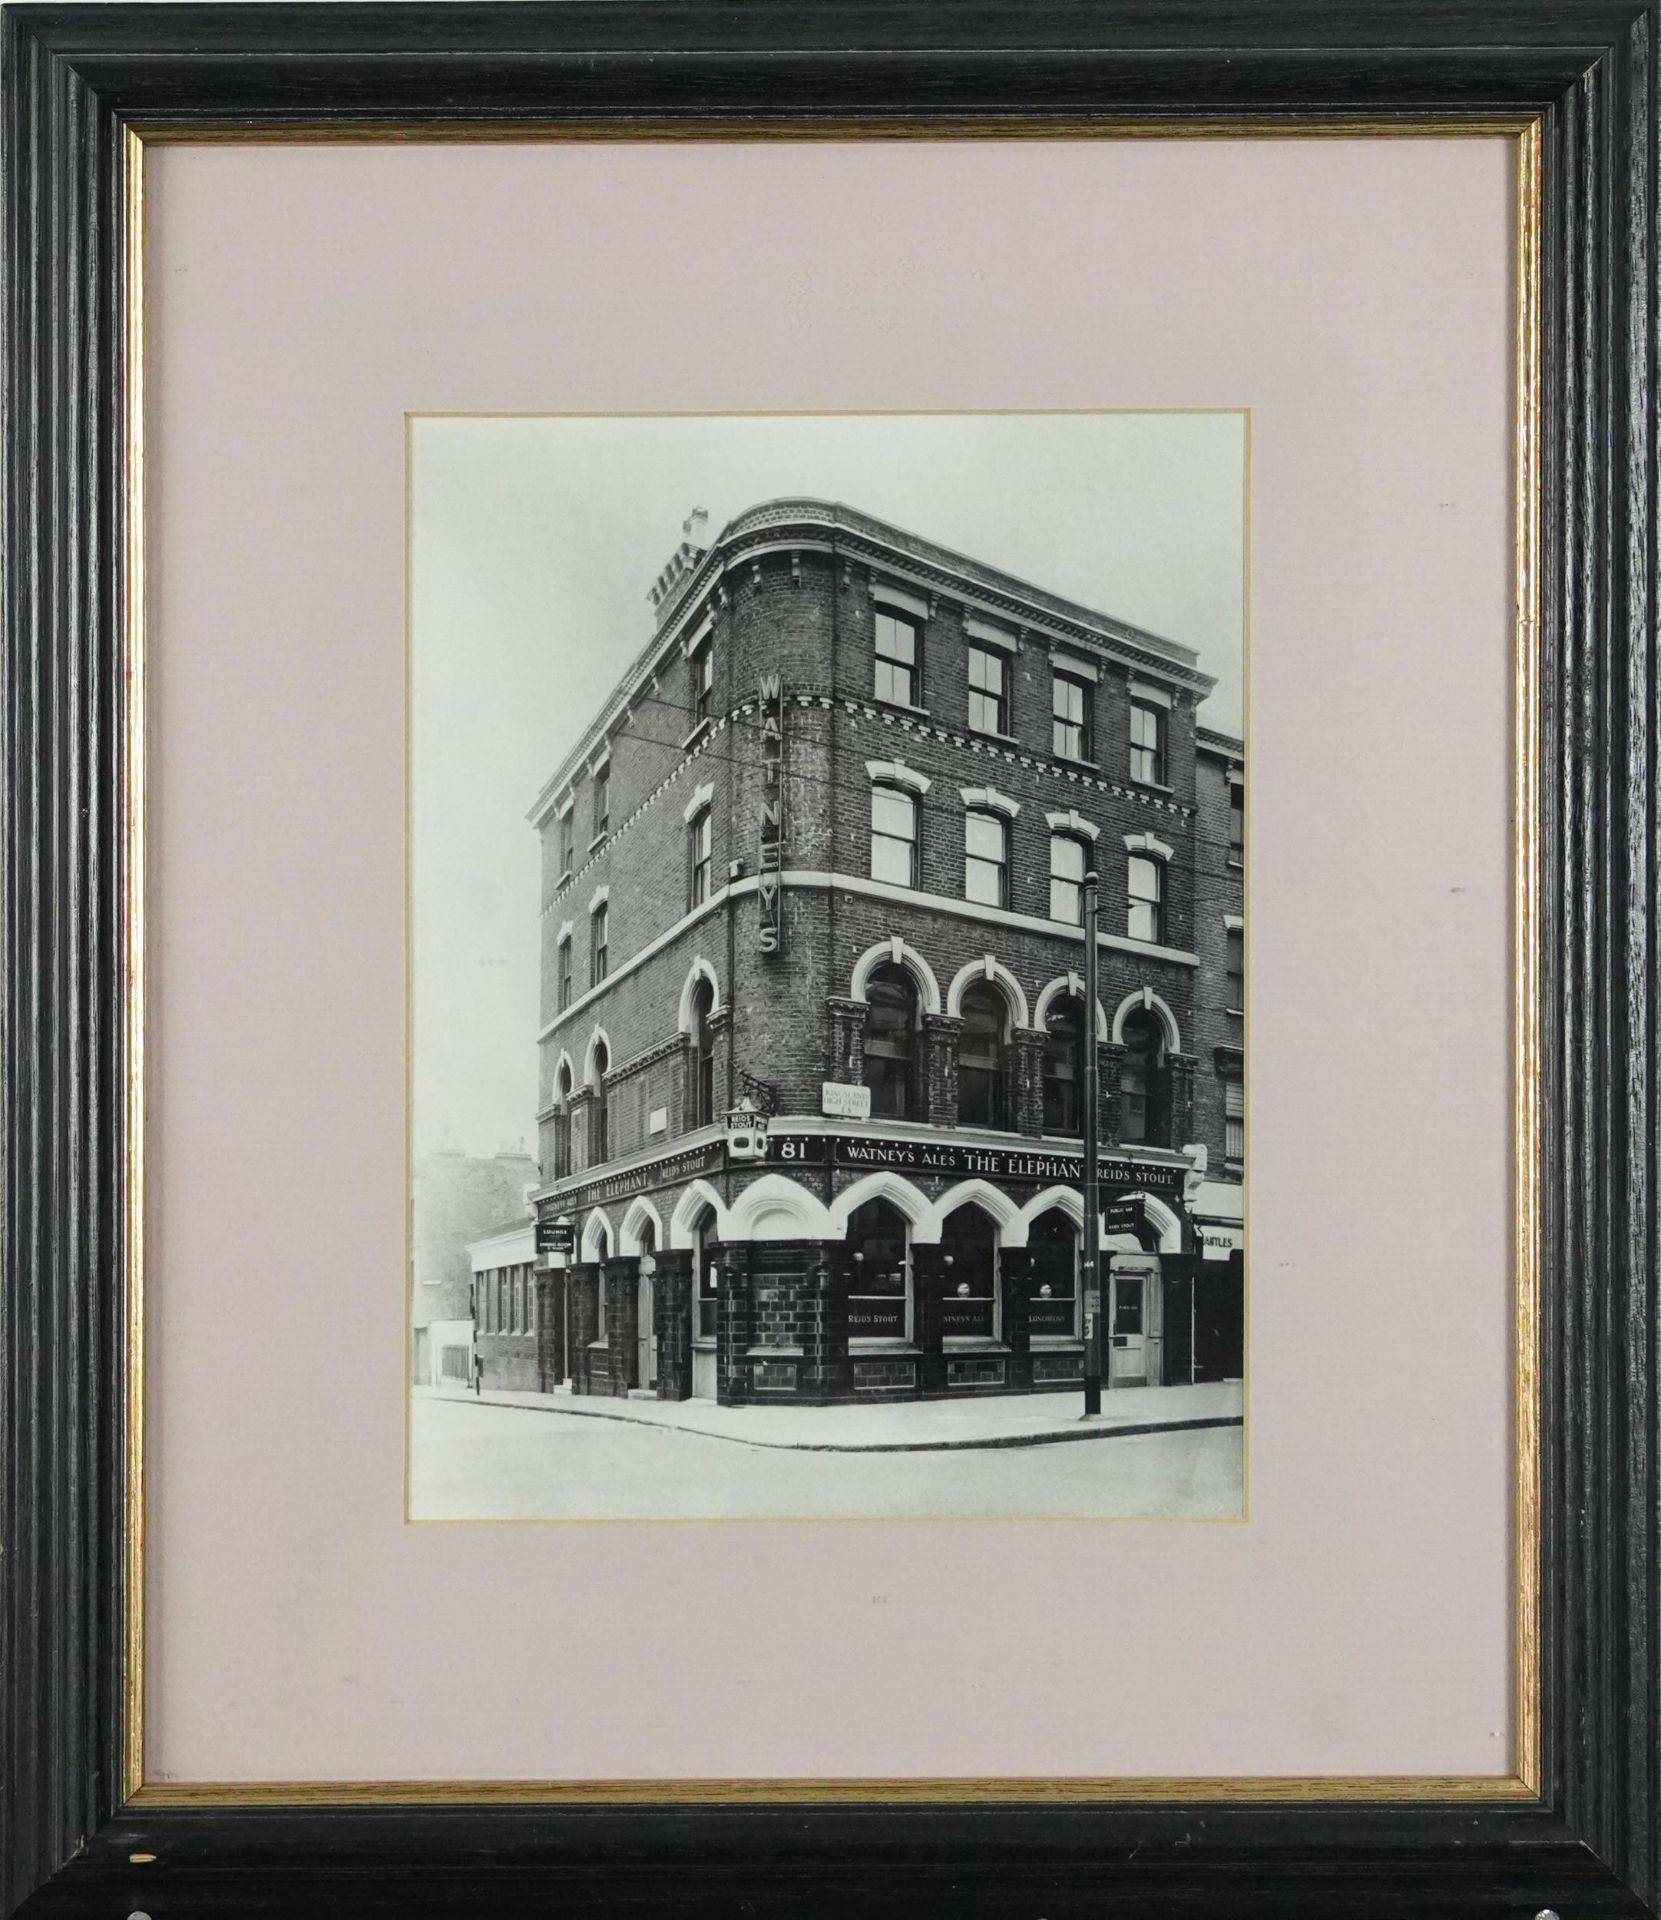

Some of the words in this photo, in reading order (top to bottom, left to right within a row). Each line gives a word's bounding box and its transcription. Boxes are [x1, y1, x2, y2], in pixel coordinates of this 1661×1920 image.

[823, 1096, 842, 1105] HIGH
[843, 1099, 869, 1108] STREET
[730, 1121, 752, 1129] STOUT
[781, 1142, 805, 1159] 81
[683, 1156, 706, 1172] STOUT
[847, 1146, 915, 1163] WATNEY'S
[922, 1153, 956, 1166] ALES
[963, 1154, 1000, 1172] THE
[1008, 1158, 1084, 1179] ELEPHAN
[587, 1189, 600, 1203] THE
[873, 1314, 899, 1323] STOUT
